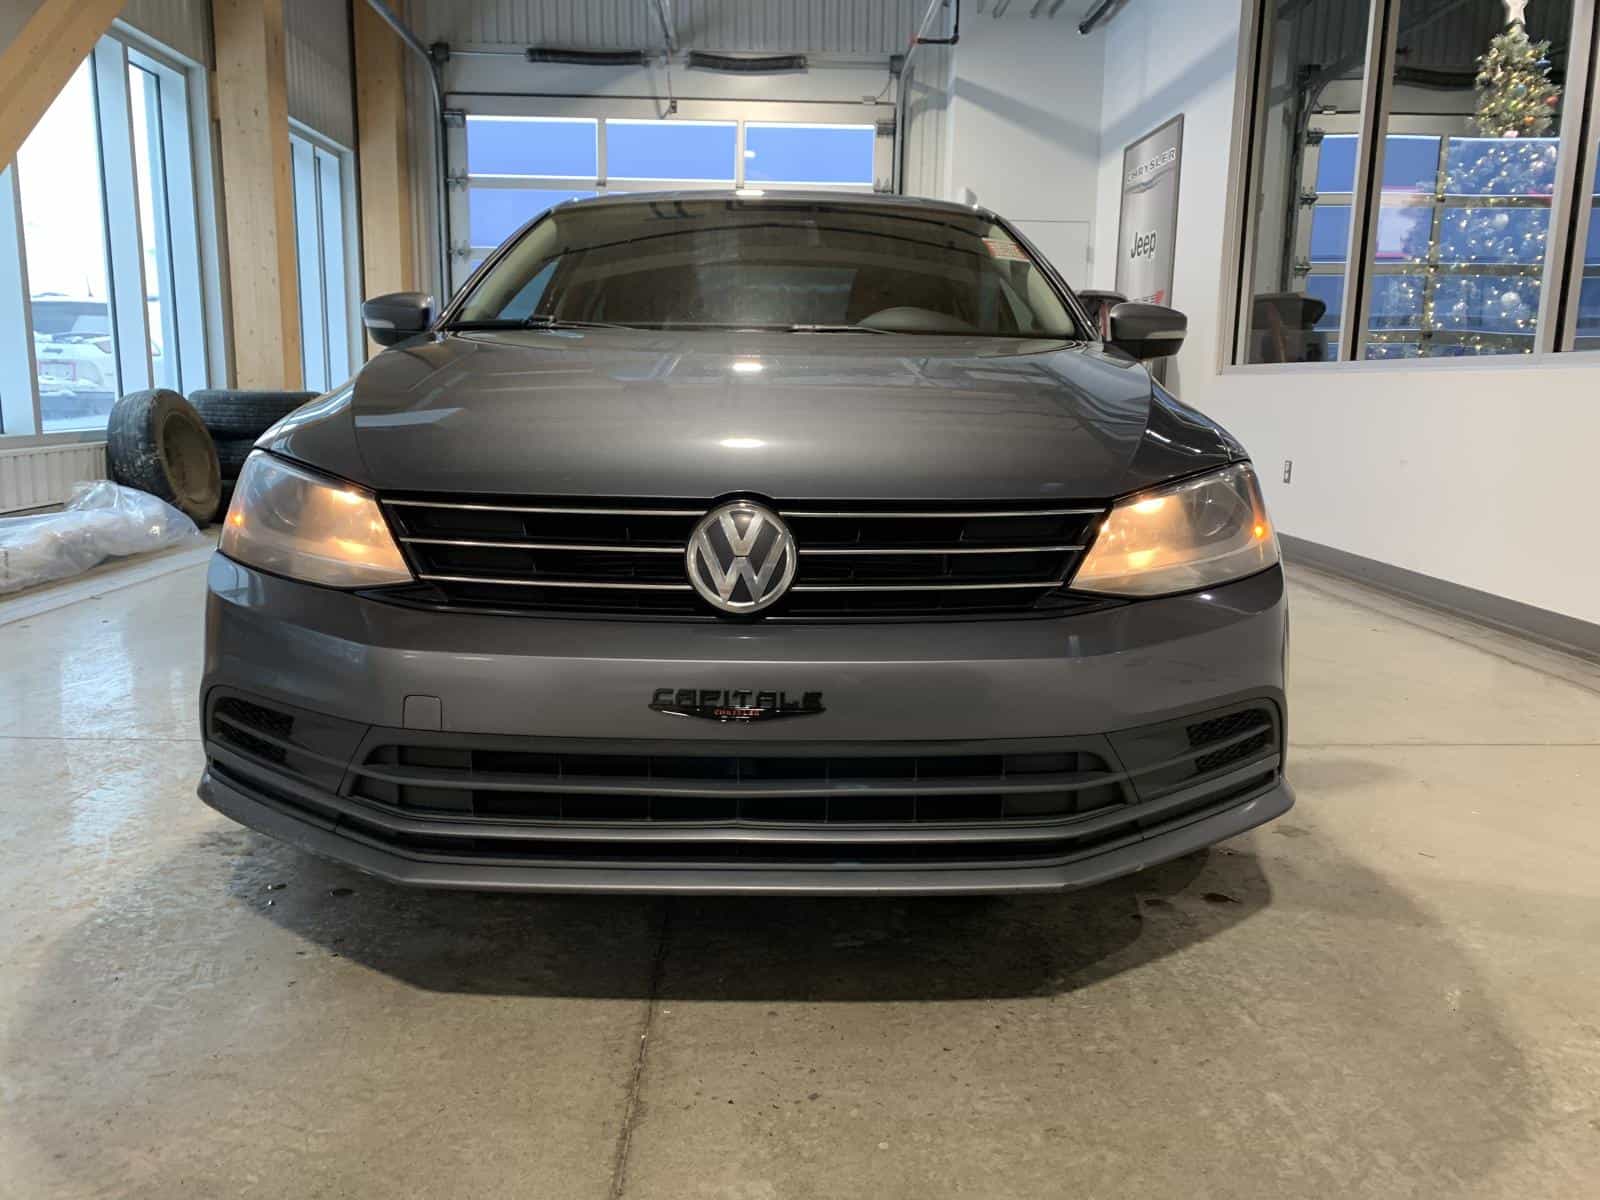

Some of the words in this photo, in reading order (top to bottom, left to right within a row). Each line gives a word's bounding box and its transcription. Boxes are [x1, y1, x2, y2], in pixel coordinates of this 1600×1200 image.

[1126, 148, 1176, 182] CHRYSLER
[1130, 231, 1157, 259] Jeep
[652, 688, 823, 708] CAPITALE
